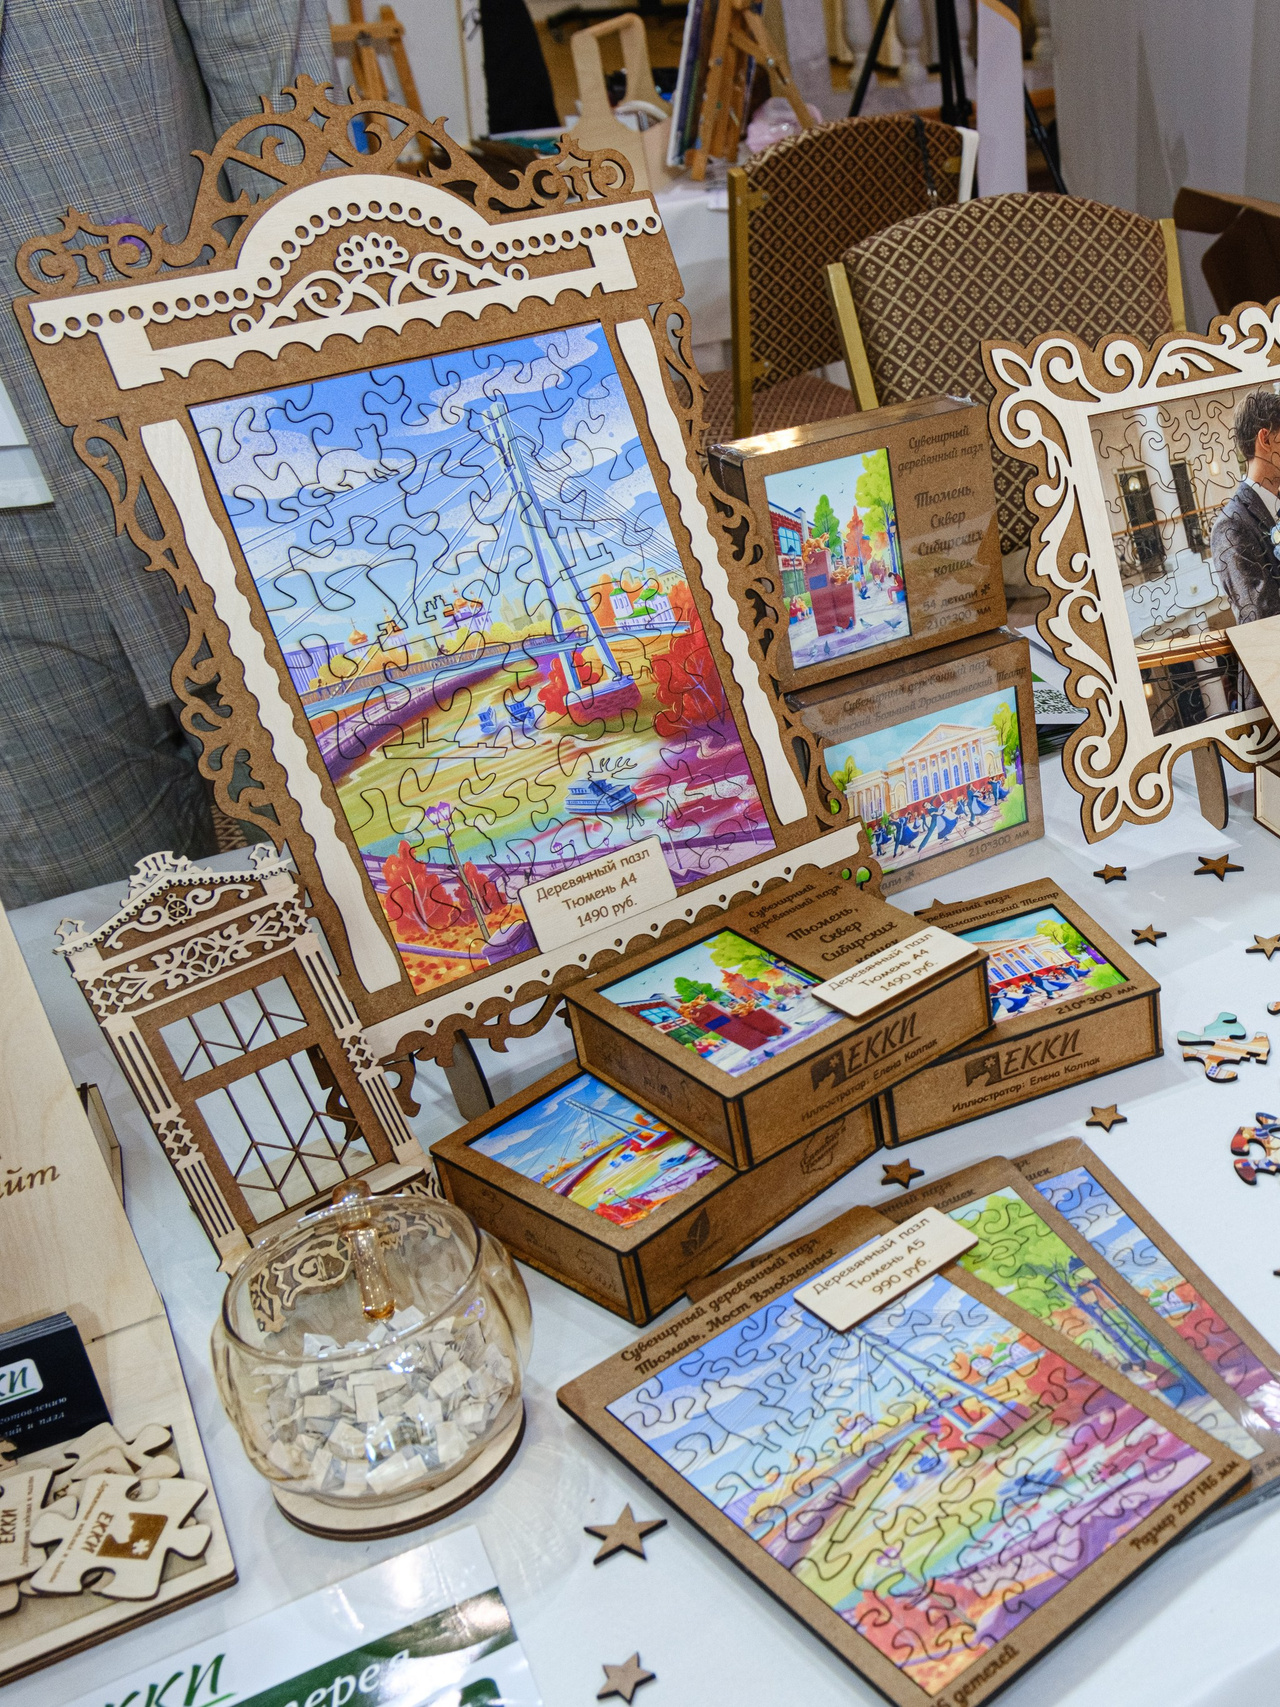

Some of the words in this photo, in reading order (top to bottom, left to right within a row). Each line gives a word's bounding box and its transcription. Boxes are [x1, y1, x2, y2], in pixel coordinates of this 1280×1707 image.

[897, 450, 958, 477] деревянный
[960, 442, 984, 463] пазл
[908, 426, 970, 453] Сувенирный
[930, 509, 966, 530] Сквер
[917, 529, 984, 556] Сибирских
[932, 557, 973, 577] кошек
[922, 599, 937, 611] 54
[842, 685, 905, 713] Сувенирный
[1014, 829, 1030, 840] мм
[536, 860, 618, 903] Деревянный
[620, 848, 651, 868] пазл
[562, 884, 617, 911] Тюмень
[620, 872, 638, 889] А4
[577, 906, 609, 928] 1490
[612, 895, 638, 916] руб.
[748, 883, 817, 920] Сувенирный
[749, 897, 815, 936] деревянный
[815, 884, 844, 900] пазл
[922, 901, 984, 924] ревянный
[986, 893, 1012, 908] пазл
[937, 901, 1020, 930] раматический
[1021, 890, 1060, 906] Театр
[786, 907, 860, 942] Тюмень,
[819, 919, 863, 944] Сквер
[821, 921, 899, 963] Сибирских
[828, 947, 904, 991] Деревянный
[904, 932, 934, 950] пазл
[858, 960, 911, 988] Тюмень
[912, 948, 930, 961] А4
[880, 973, 913, 992] 1490
[914, 959, 939, 976] руб.
[1117, 983, 1139, 995] мм
[847, 1011, 917, 1073] ЕККИ
[1002, 1028, 1082, 1076] ЕККИ
[802, 1078, 870, 1122] Иллюстратор:
[873, 1061, 902, 1081] Елена
[904, 1038, 939, 1062] Колпак
[952, 1082, 1026, 1113] Иллюстратор:
[1029, 1068, 1061, 1087] Елена
[1063, 1055, 1101, 1074] Колпак
[812, 1237, 898, 1296] Деревянный
[898, 1216, 930, 1240] пазл
[845, 1252, 905, 1291] Тюмень
[905, 1237, 926, 1257] А5
[872, 1273, 903, 1296] 990
[903, 1256, 932, 1280] руб.
[621, 1300, 708, 1363] Сувенирный
[708, 1256, 790, 1315] деревянный
[789, 1237, 819, 1265] пазл
[706, 1301, 752, 1334] Мост
[749, 1246, 838, 1309] Влюбленных
[0, 1396, 68, 1425] готовлению
[1129, 1512, 1176, 1551] Размер
[1217, 1460, 1241, 1480] мм
[81, 1511, 115, 1554] ЕККИ
[952, 1642, 1020, 1707] деталей
